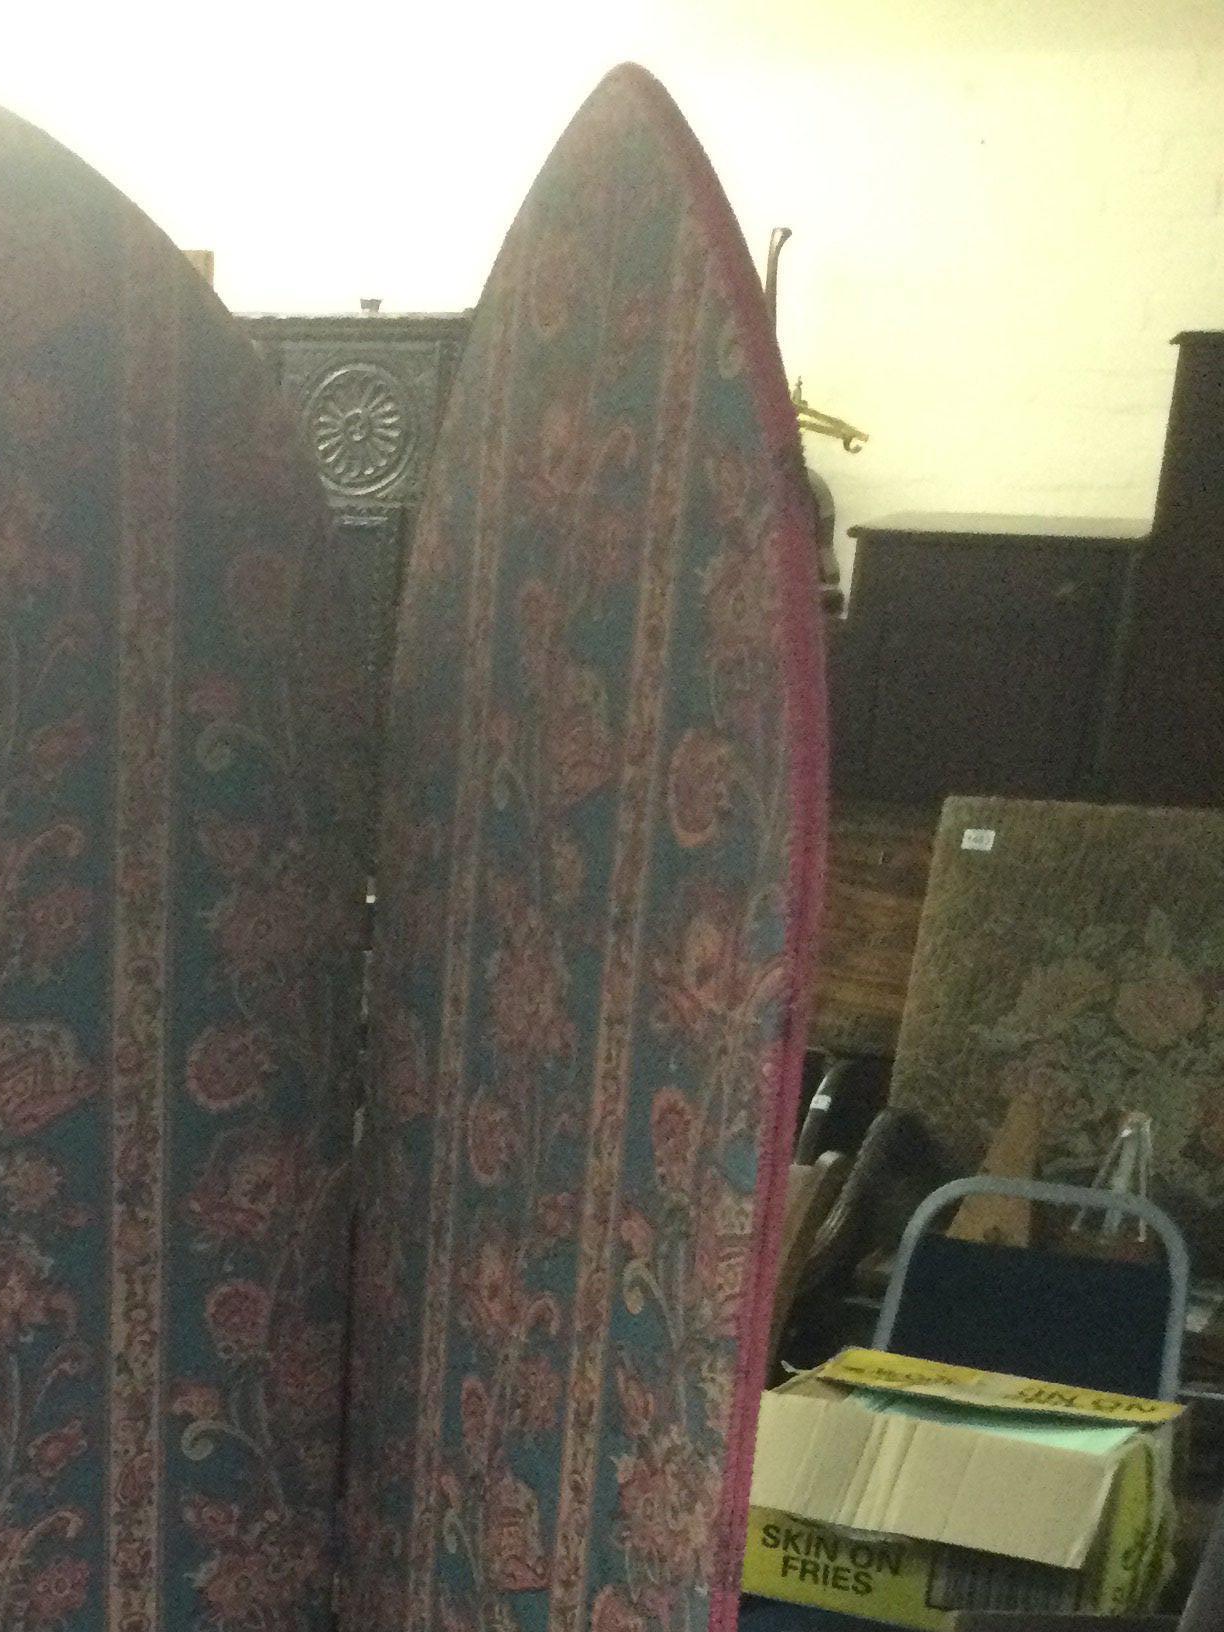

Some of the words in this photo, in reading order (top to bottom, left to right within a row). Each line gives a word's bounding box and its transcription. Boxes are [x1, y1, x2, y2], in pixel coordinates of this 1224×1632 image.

[761, 1523, 839, 1563] SKIN
[849, 1541, 904, 1578] ON
[780, 1555, 874, 1597] FRIES
